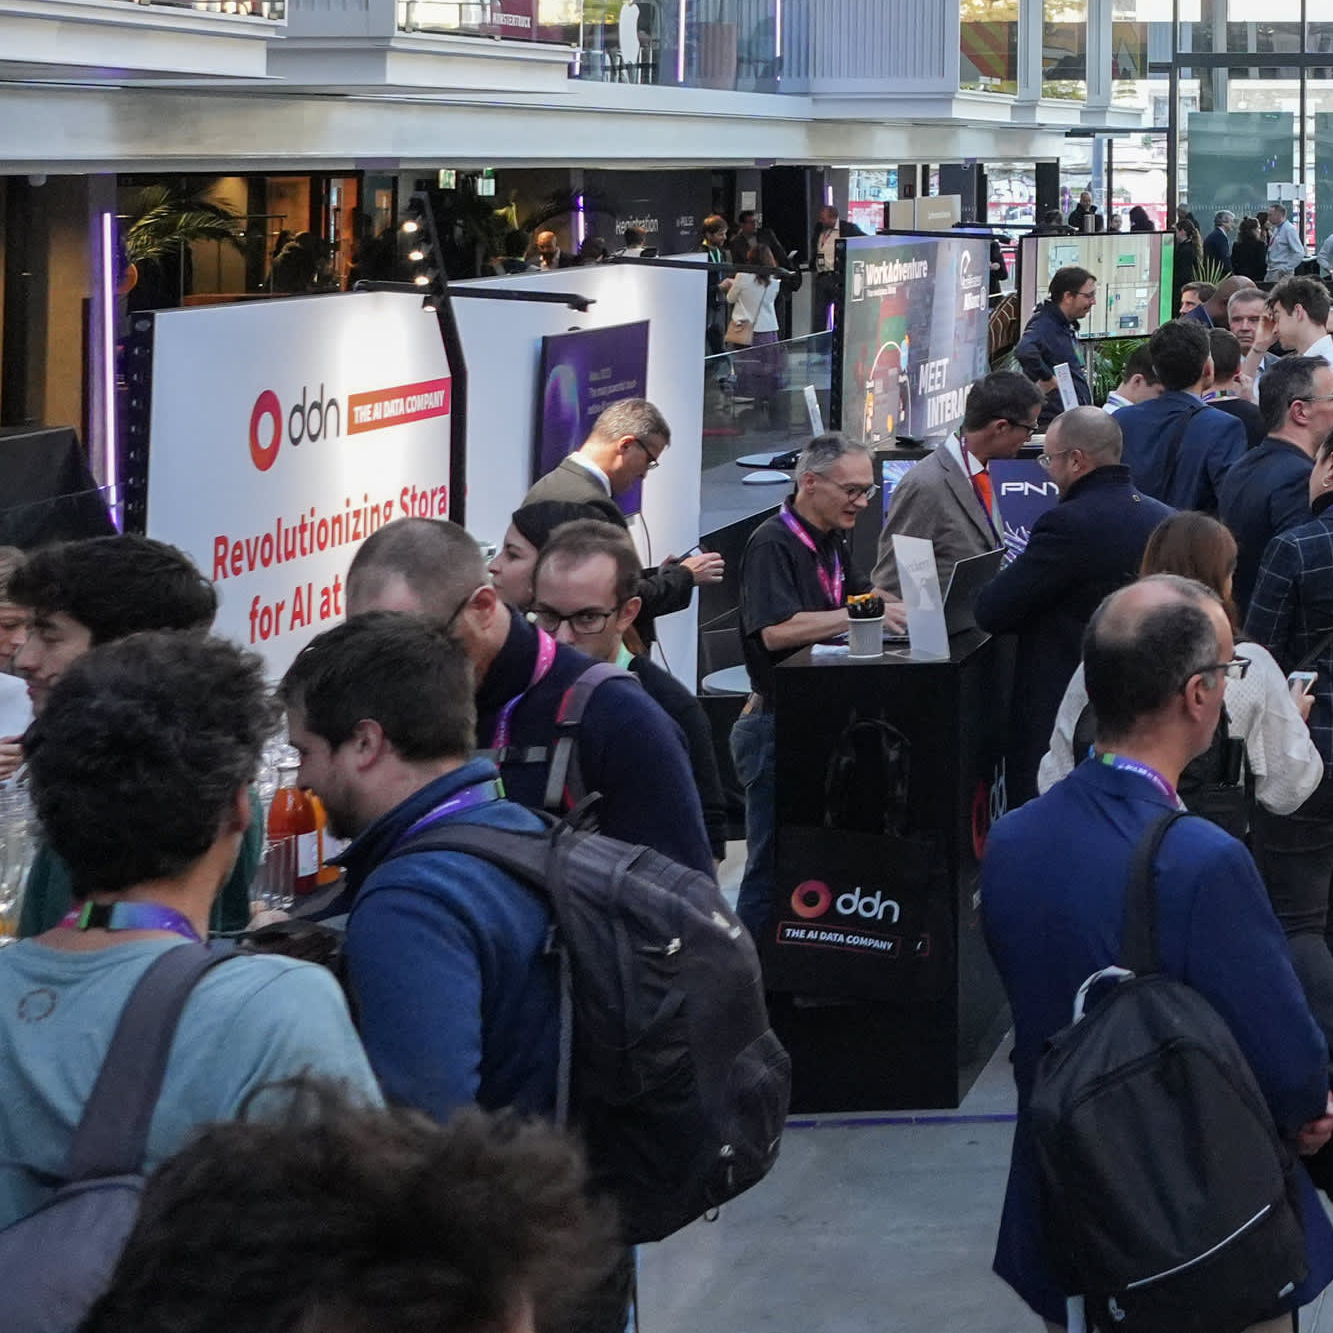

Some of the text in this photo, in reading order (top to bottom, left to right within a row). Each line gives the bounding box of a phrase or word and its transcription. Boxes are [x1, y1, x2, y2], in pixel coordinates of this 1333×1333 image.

[919, 358, 949, 395] MEET
[288, 383, 446, 446] ddn THE AI DATA COMPANY
[212, 484, 448, 582] Revolutionizing Stora
[249, 574, 343, 644] for AI at
[836, 887, 900, 923] ddn
[784, 928, 893, 951] THE AI DATA COMPANY
